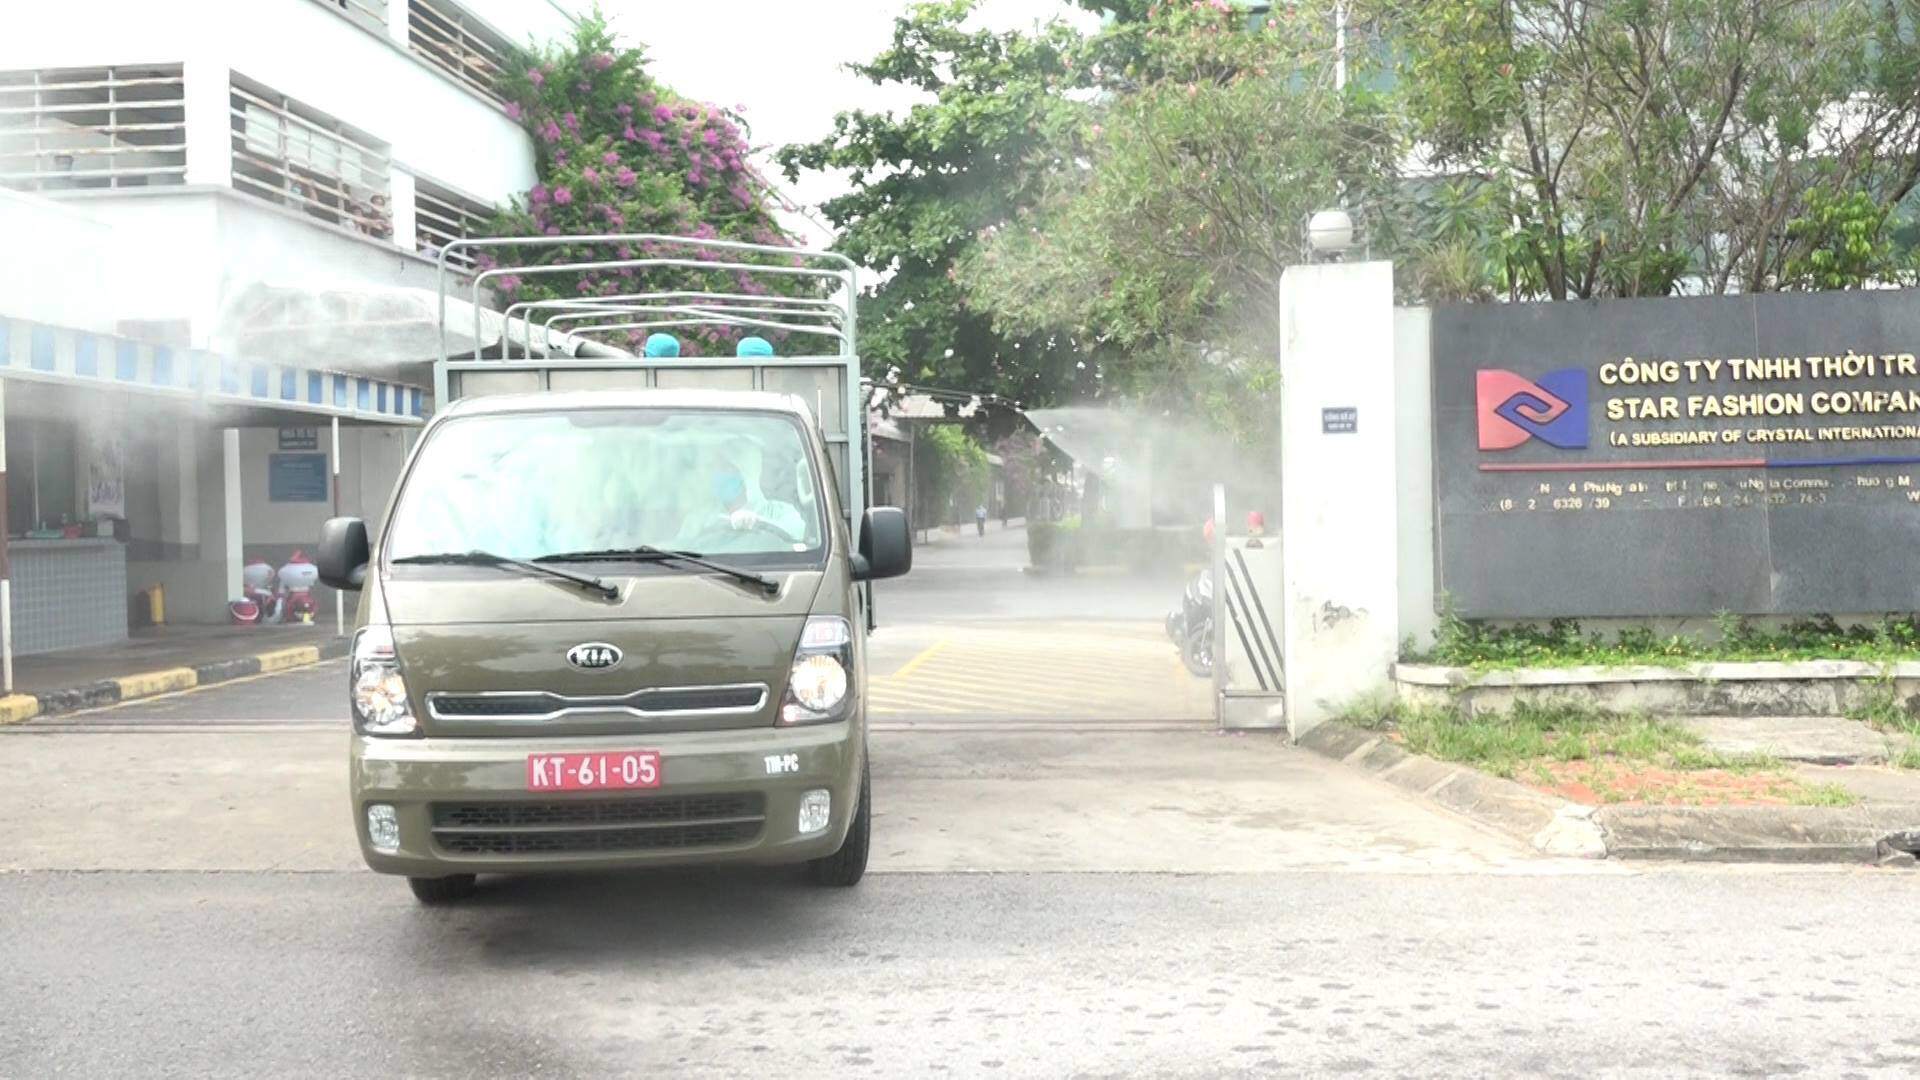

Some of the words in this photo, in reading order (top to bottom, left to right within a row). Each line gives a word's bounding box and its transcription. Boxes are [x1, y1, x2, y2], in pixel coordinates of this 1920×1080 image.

[1599, 356, 1680, 385] CÔNG
[1683, 358, 1722, 383] TY
[1727, 356, 1802, 381] TNHH
[1805, 349, 1875, 379] THỜI
[1879, 352, 1920, 377] TR
[1606, 396, 1680, 421] STAR
[1687, 392, 1804, 418] FASHION
[1631, 430, 1719, 447] SUBSIDIARY
[1721, 428, 1743, 443] OF
[1746, 426, 1814, 443] CRYSTAL
[576, 648, 614, 666] KIA
[532, 755, 656, 787] KT-61-05
